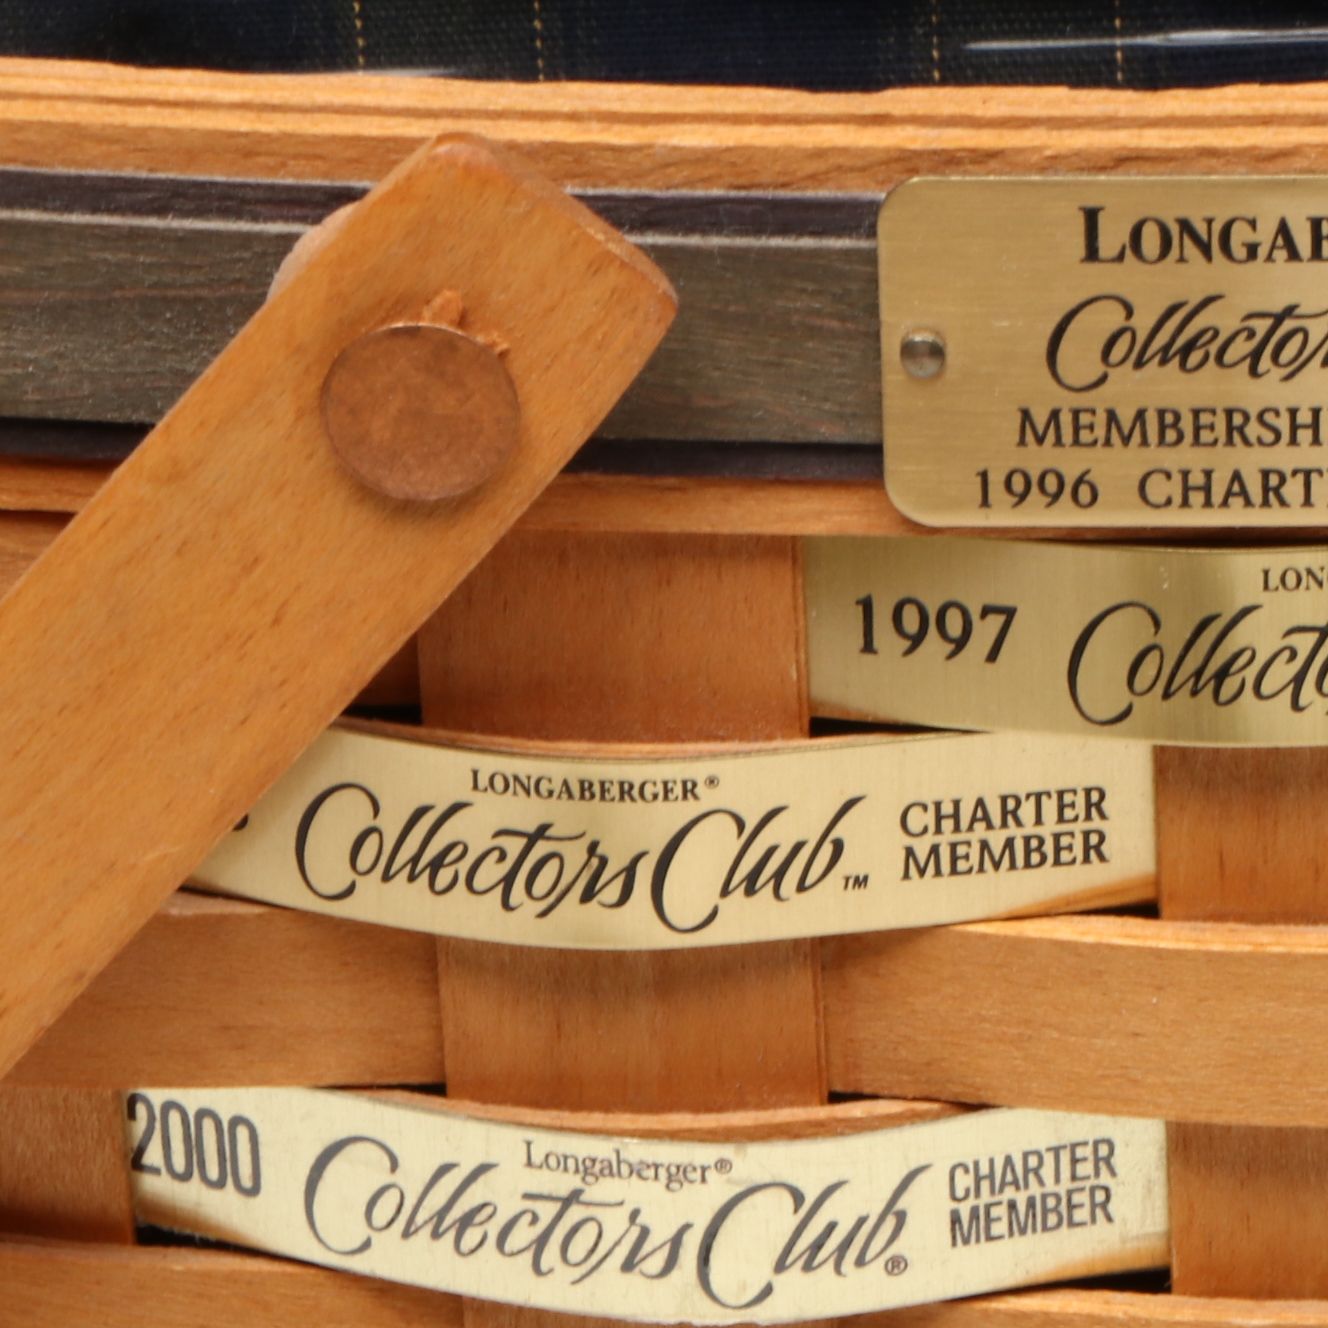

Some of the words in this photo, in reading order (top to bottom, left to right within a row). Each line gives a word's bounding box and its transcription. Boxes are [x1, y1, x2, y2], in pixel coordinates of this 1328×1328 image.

[975, 468, 1099, 510] 1996
[855, 592, 1018, 664] 1997
[899, 786, 1109, 838] CHARTER
[294, 783, 648, 919] Collectors
[899, 829, 1109, 883] MEMBER
[127, 1092, 262, 1198] 2000
[947, 1138, 1118, 1202] CHARTER
[304, 1134, 692, 1286] Collectors
[949, 1187, 1114, 1247] MEMBER
